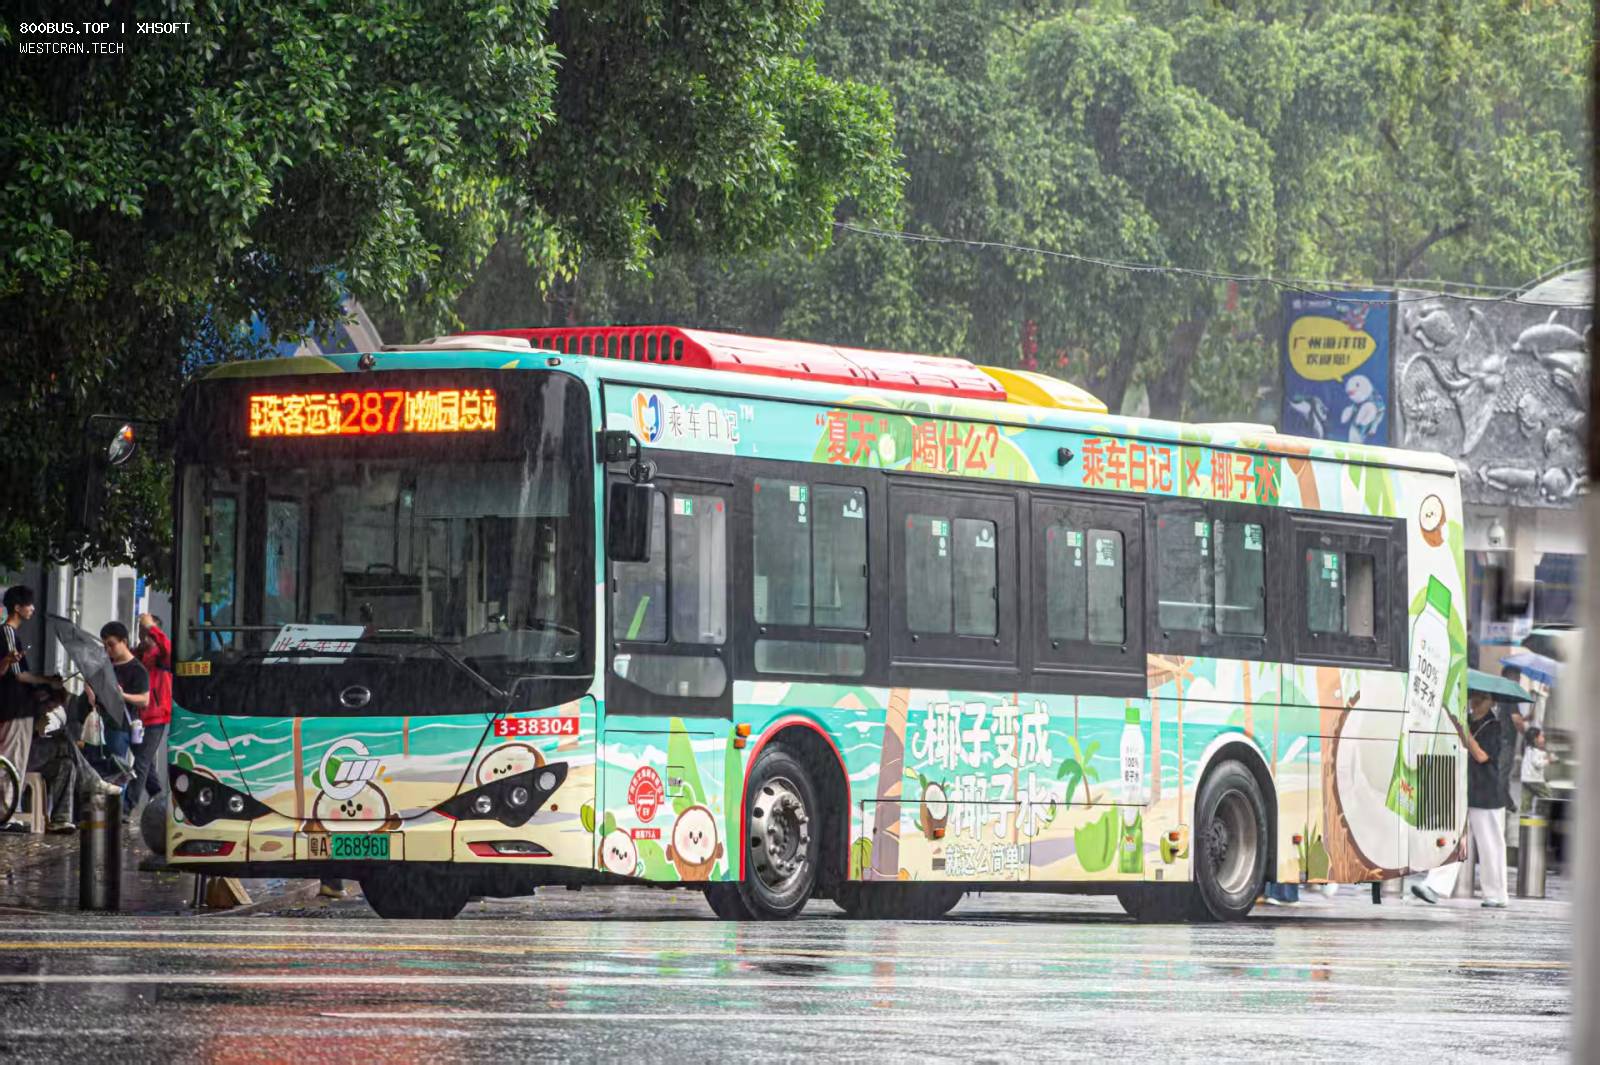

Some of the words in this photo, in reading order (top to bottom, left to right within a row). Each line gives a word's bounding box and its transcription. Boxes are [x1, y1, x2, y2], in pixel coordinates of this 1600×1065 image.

[341, 391, 404, 433] 287
[668, 404, 739, 442] 乘车日记
[1082, 438, 1173, 492] 乘车日记
[1211, 449, 1280, 502] 椰子水
[498, 719, 574, 735] 3-38304
[911, 697, 1053, 770] 椰子变成
[949, 771, 1057, 841] 椰子水
[335, 837, 389, 857] 26896D
